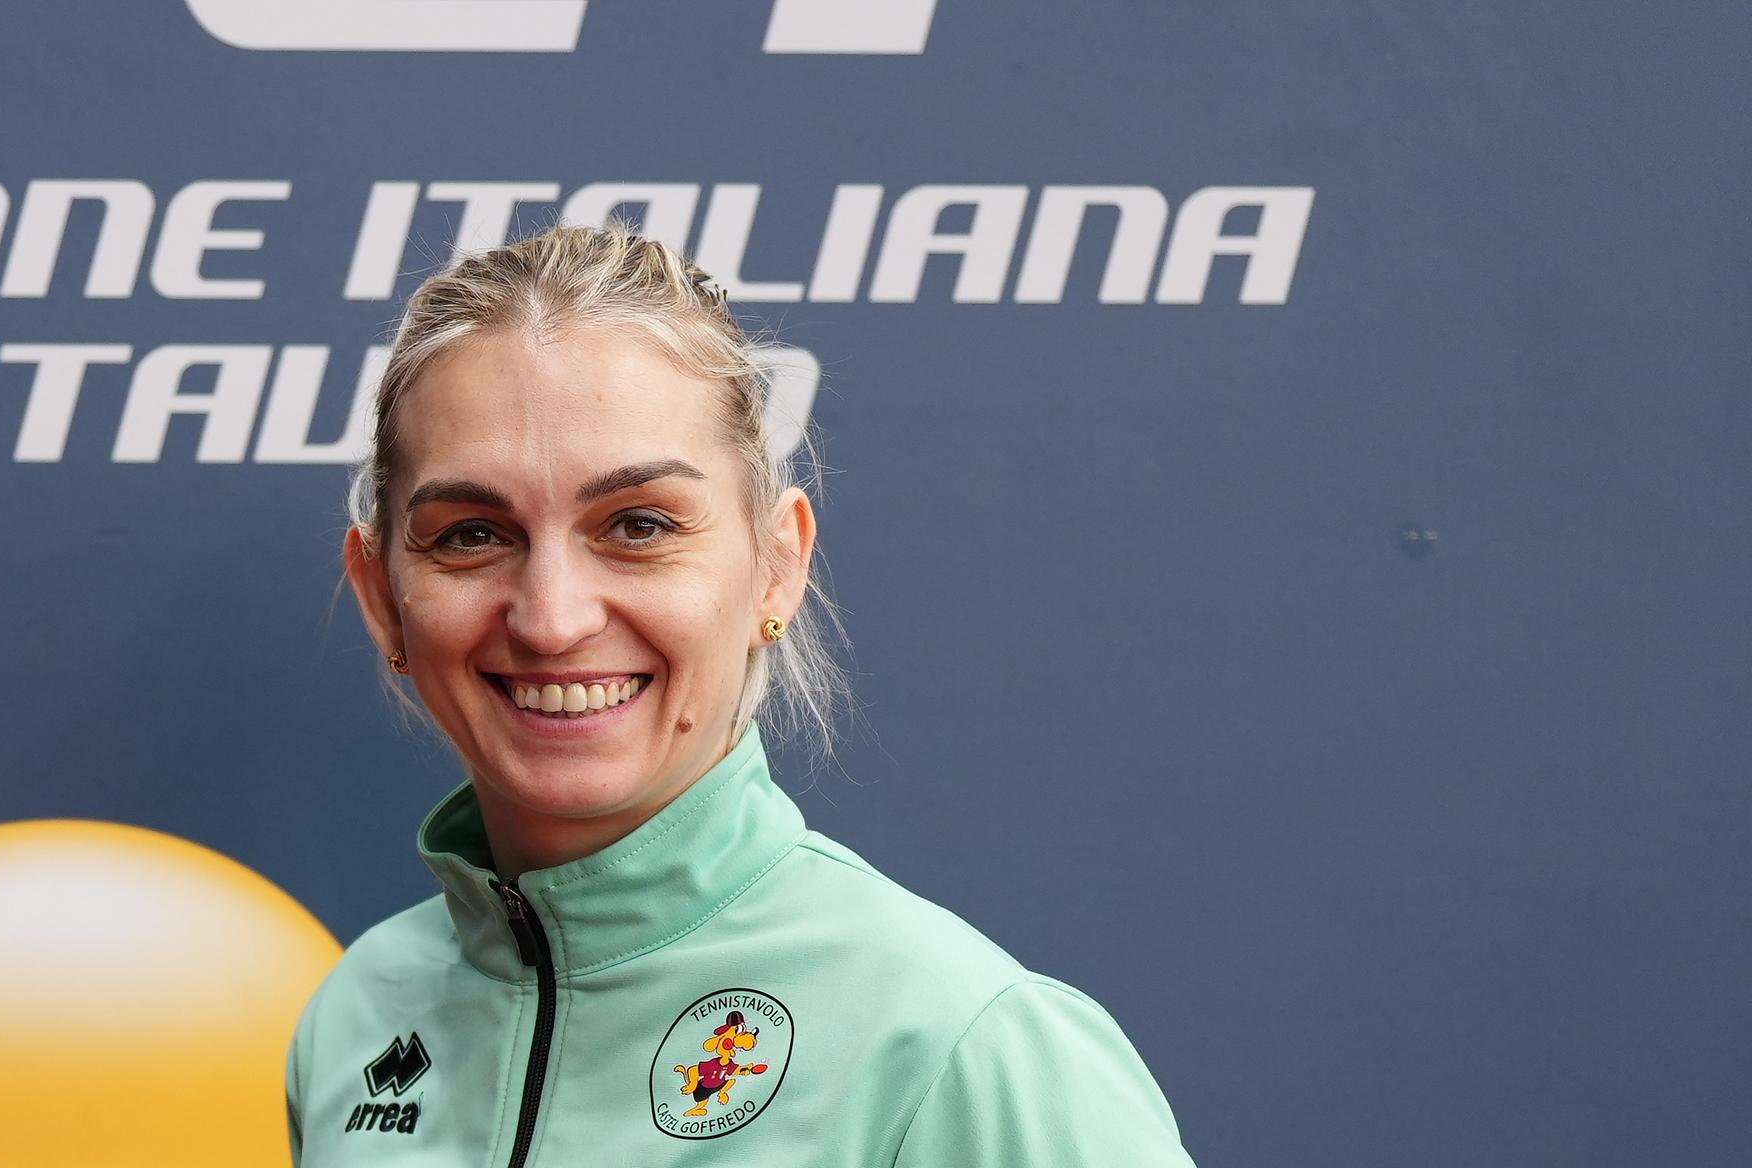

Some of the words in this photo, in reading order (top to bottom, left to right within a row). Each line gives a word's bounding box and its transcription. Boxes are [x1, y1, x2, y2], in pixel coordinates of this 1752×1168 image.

[690, 995, 785, 1028] TENNISTAVOLO
[656, 1102, 680, 1132] CASTEL
[679, 1099, 757, 1134] GOFFREDO
